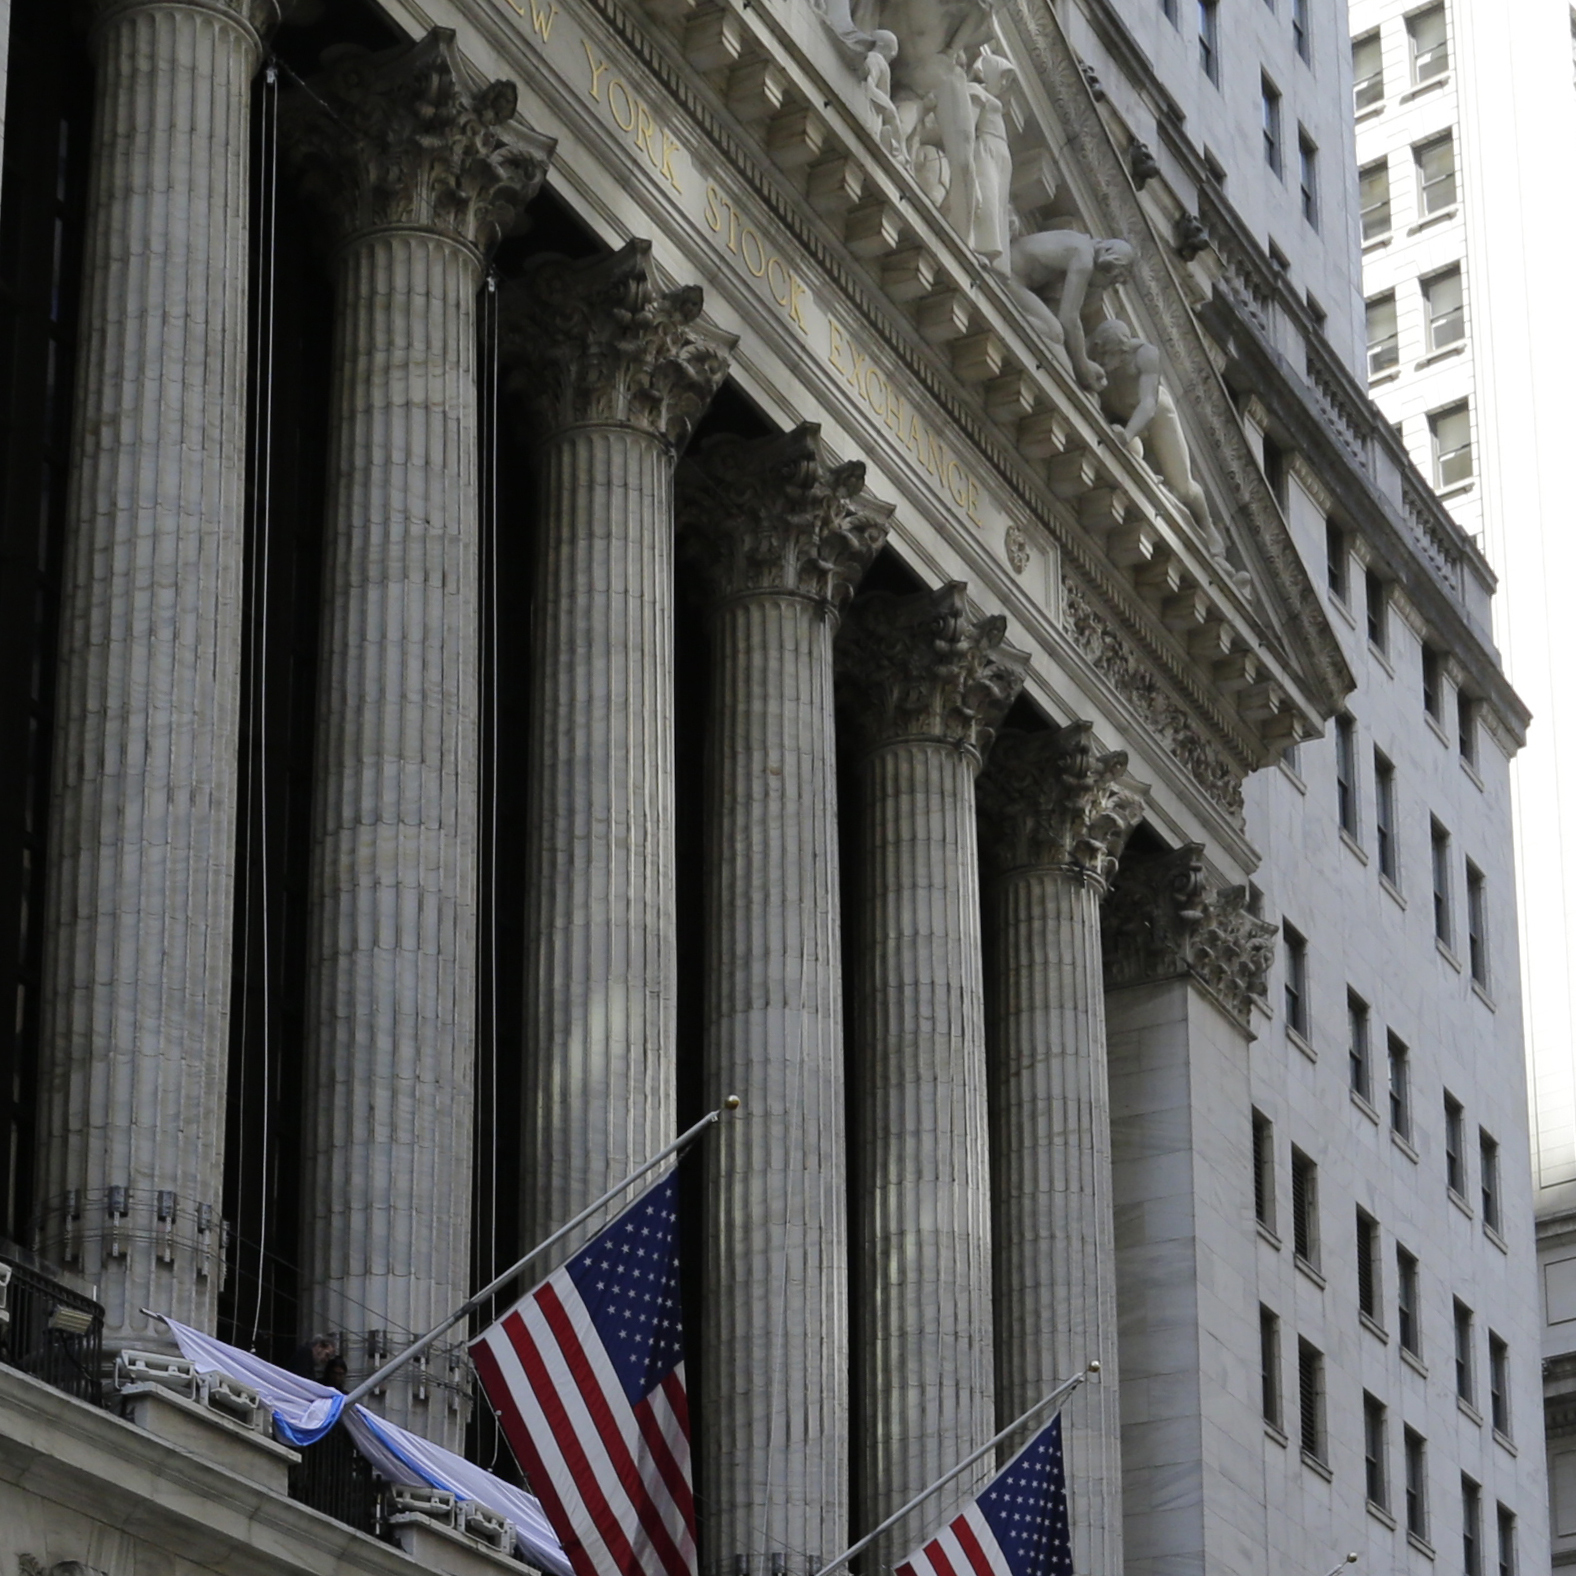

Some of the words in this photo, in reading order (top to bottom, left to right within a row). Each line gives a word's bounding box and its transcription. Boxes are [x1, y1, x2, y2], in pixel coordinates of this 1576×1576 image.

[581, 38, 683, 195] YORK
[704, 177, 808, 336] STOCK
[827, 314, 983, 529] EXCHANGE
